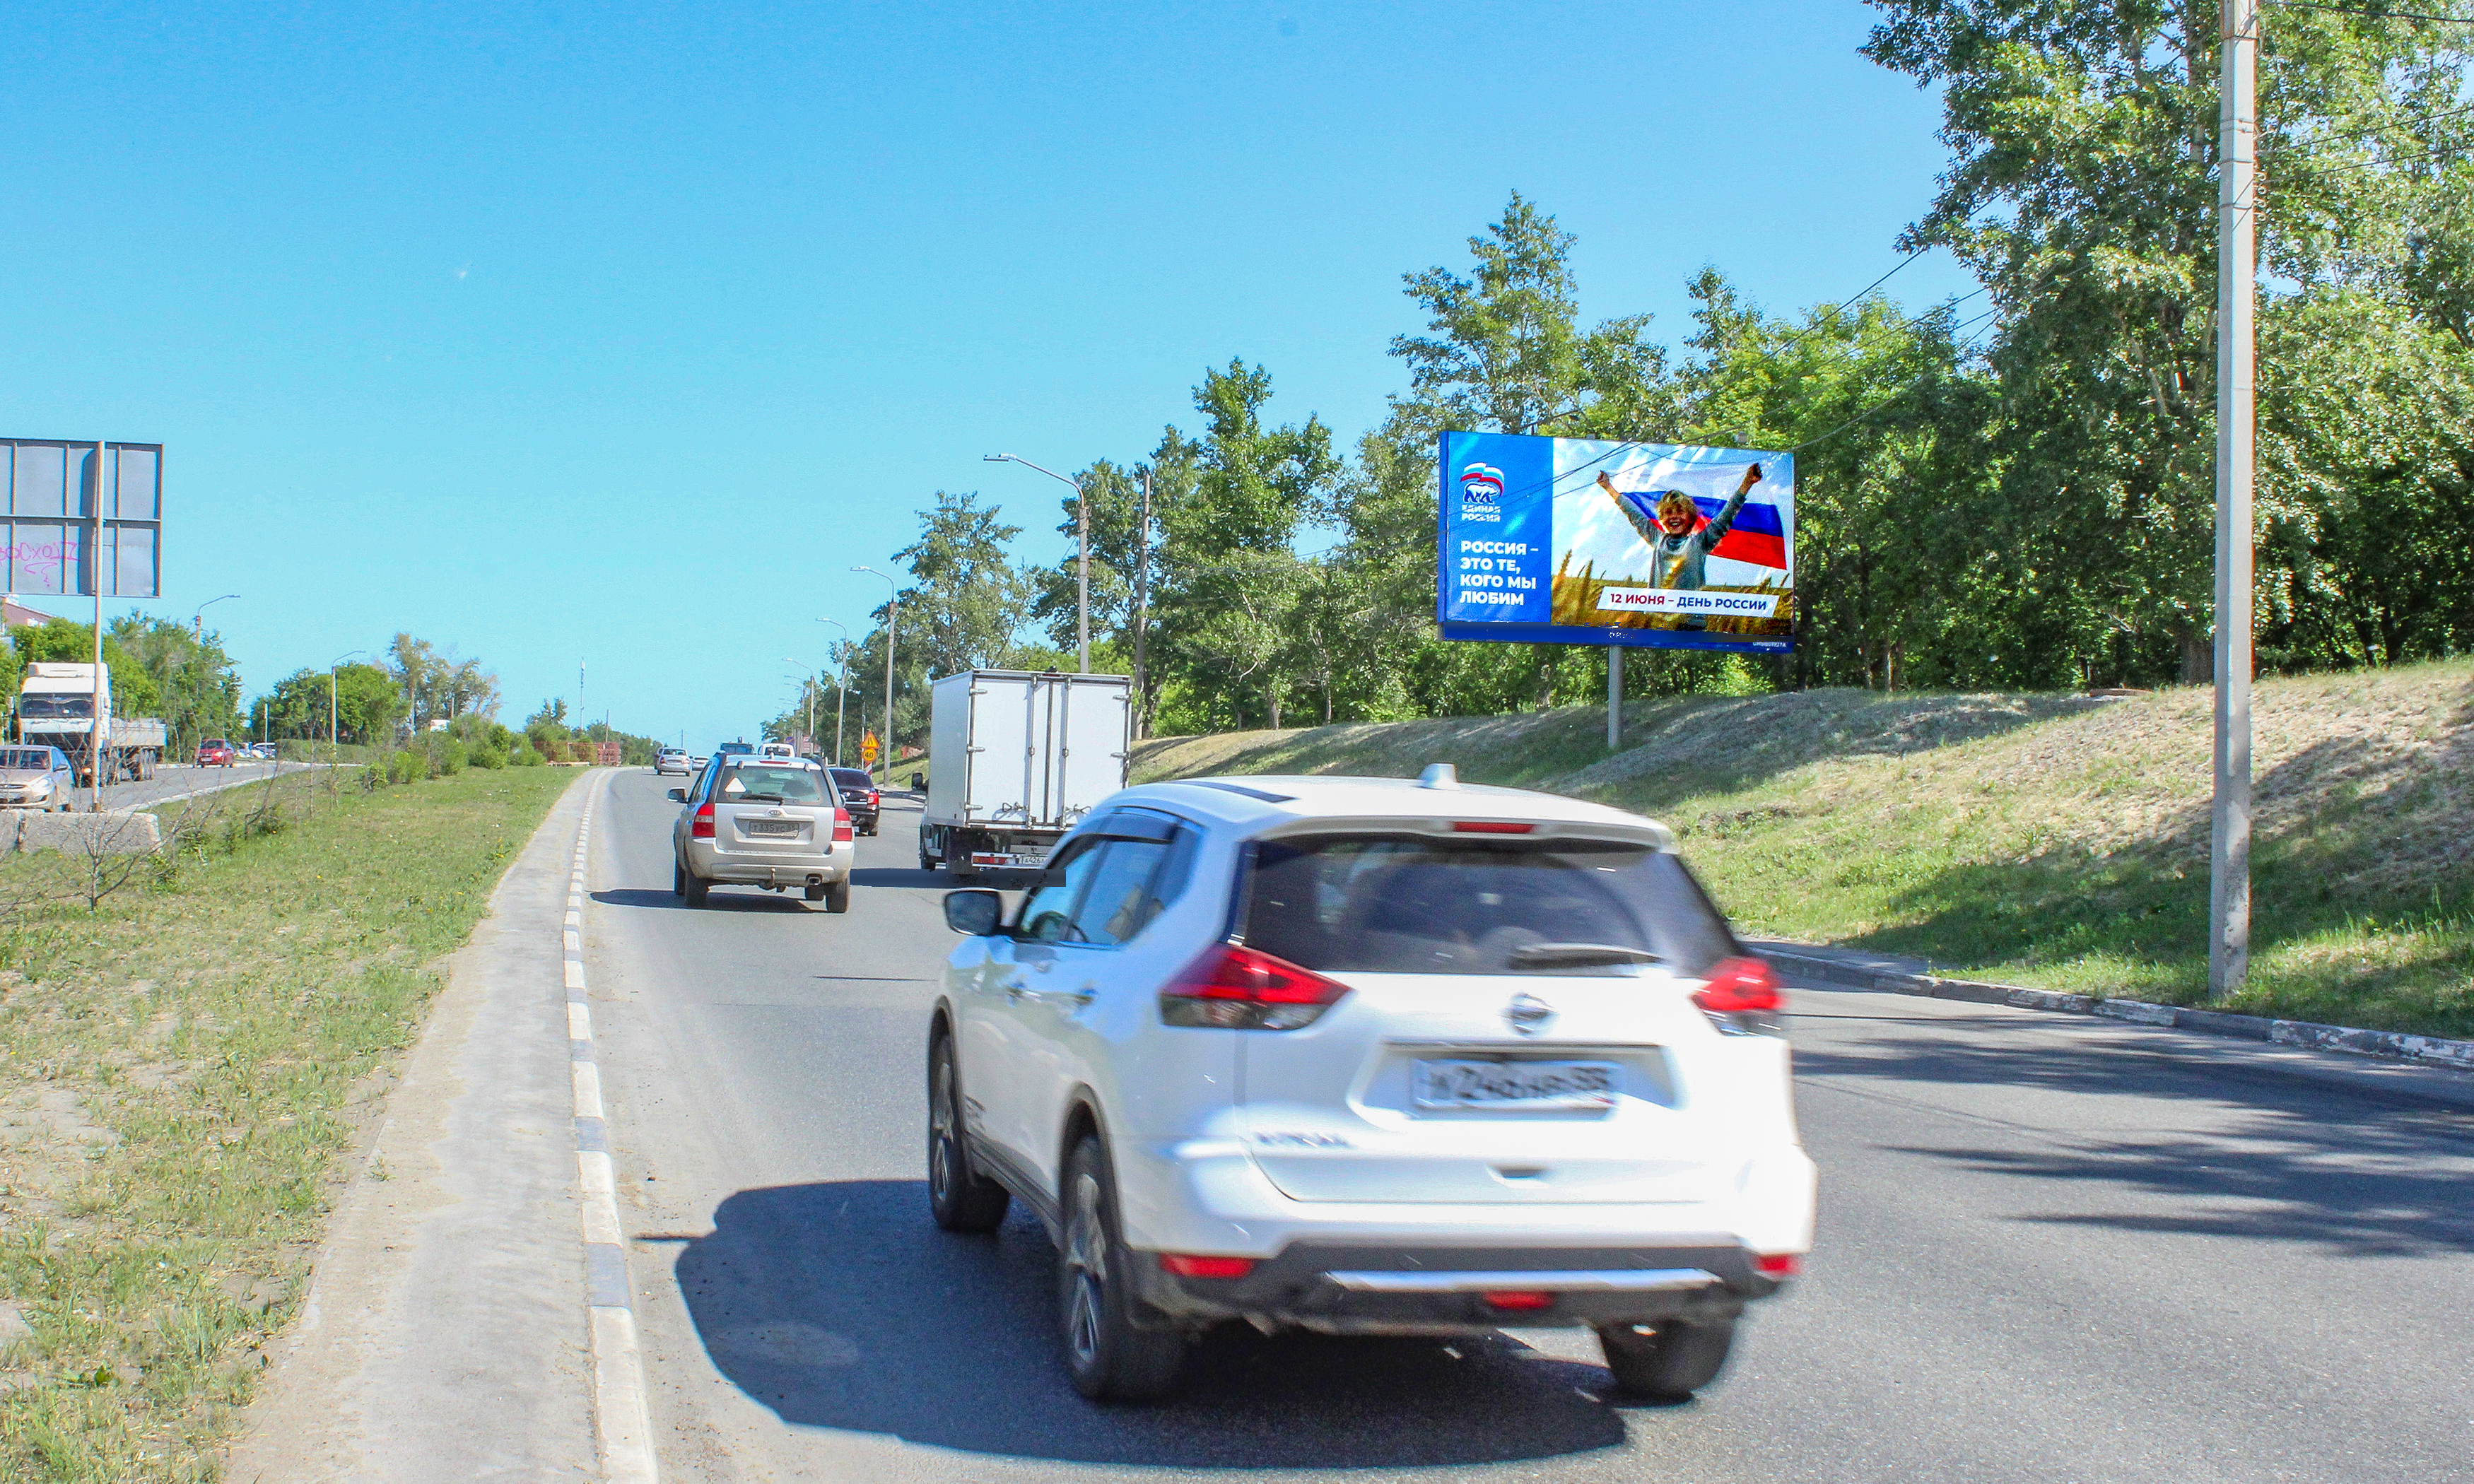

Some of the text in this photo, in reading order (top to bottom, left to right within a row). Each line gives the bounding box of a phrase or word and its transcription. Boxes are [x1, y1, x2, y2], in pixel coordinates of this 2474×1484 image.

[1462, 505, 1501, 513] ЕДИНАЯ
[1462, 513, 1501, 522] РОССИЯ
[1460, 541, 1527, 555] РОССИЯ
[1460, 558, 1520, 575] ЭТО ТЕ,
[1460, 574, 1536, 589] КОГО МЫ
[1460, 591, 1524, 605] ЛЮБИМ
[1610, 594, 1622, 603] 12
[1625, 594, 1665, 605] ИЮНЯ
[1677, 596, 1711, 608] ДЕНЬ
[1716, 599, 1766, 611] РОССИИ
